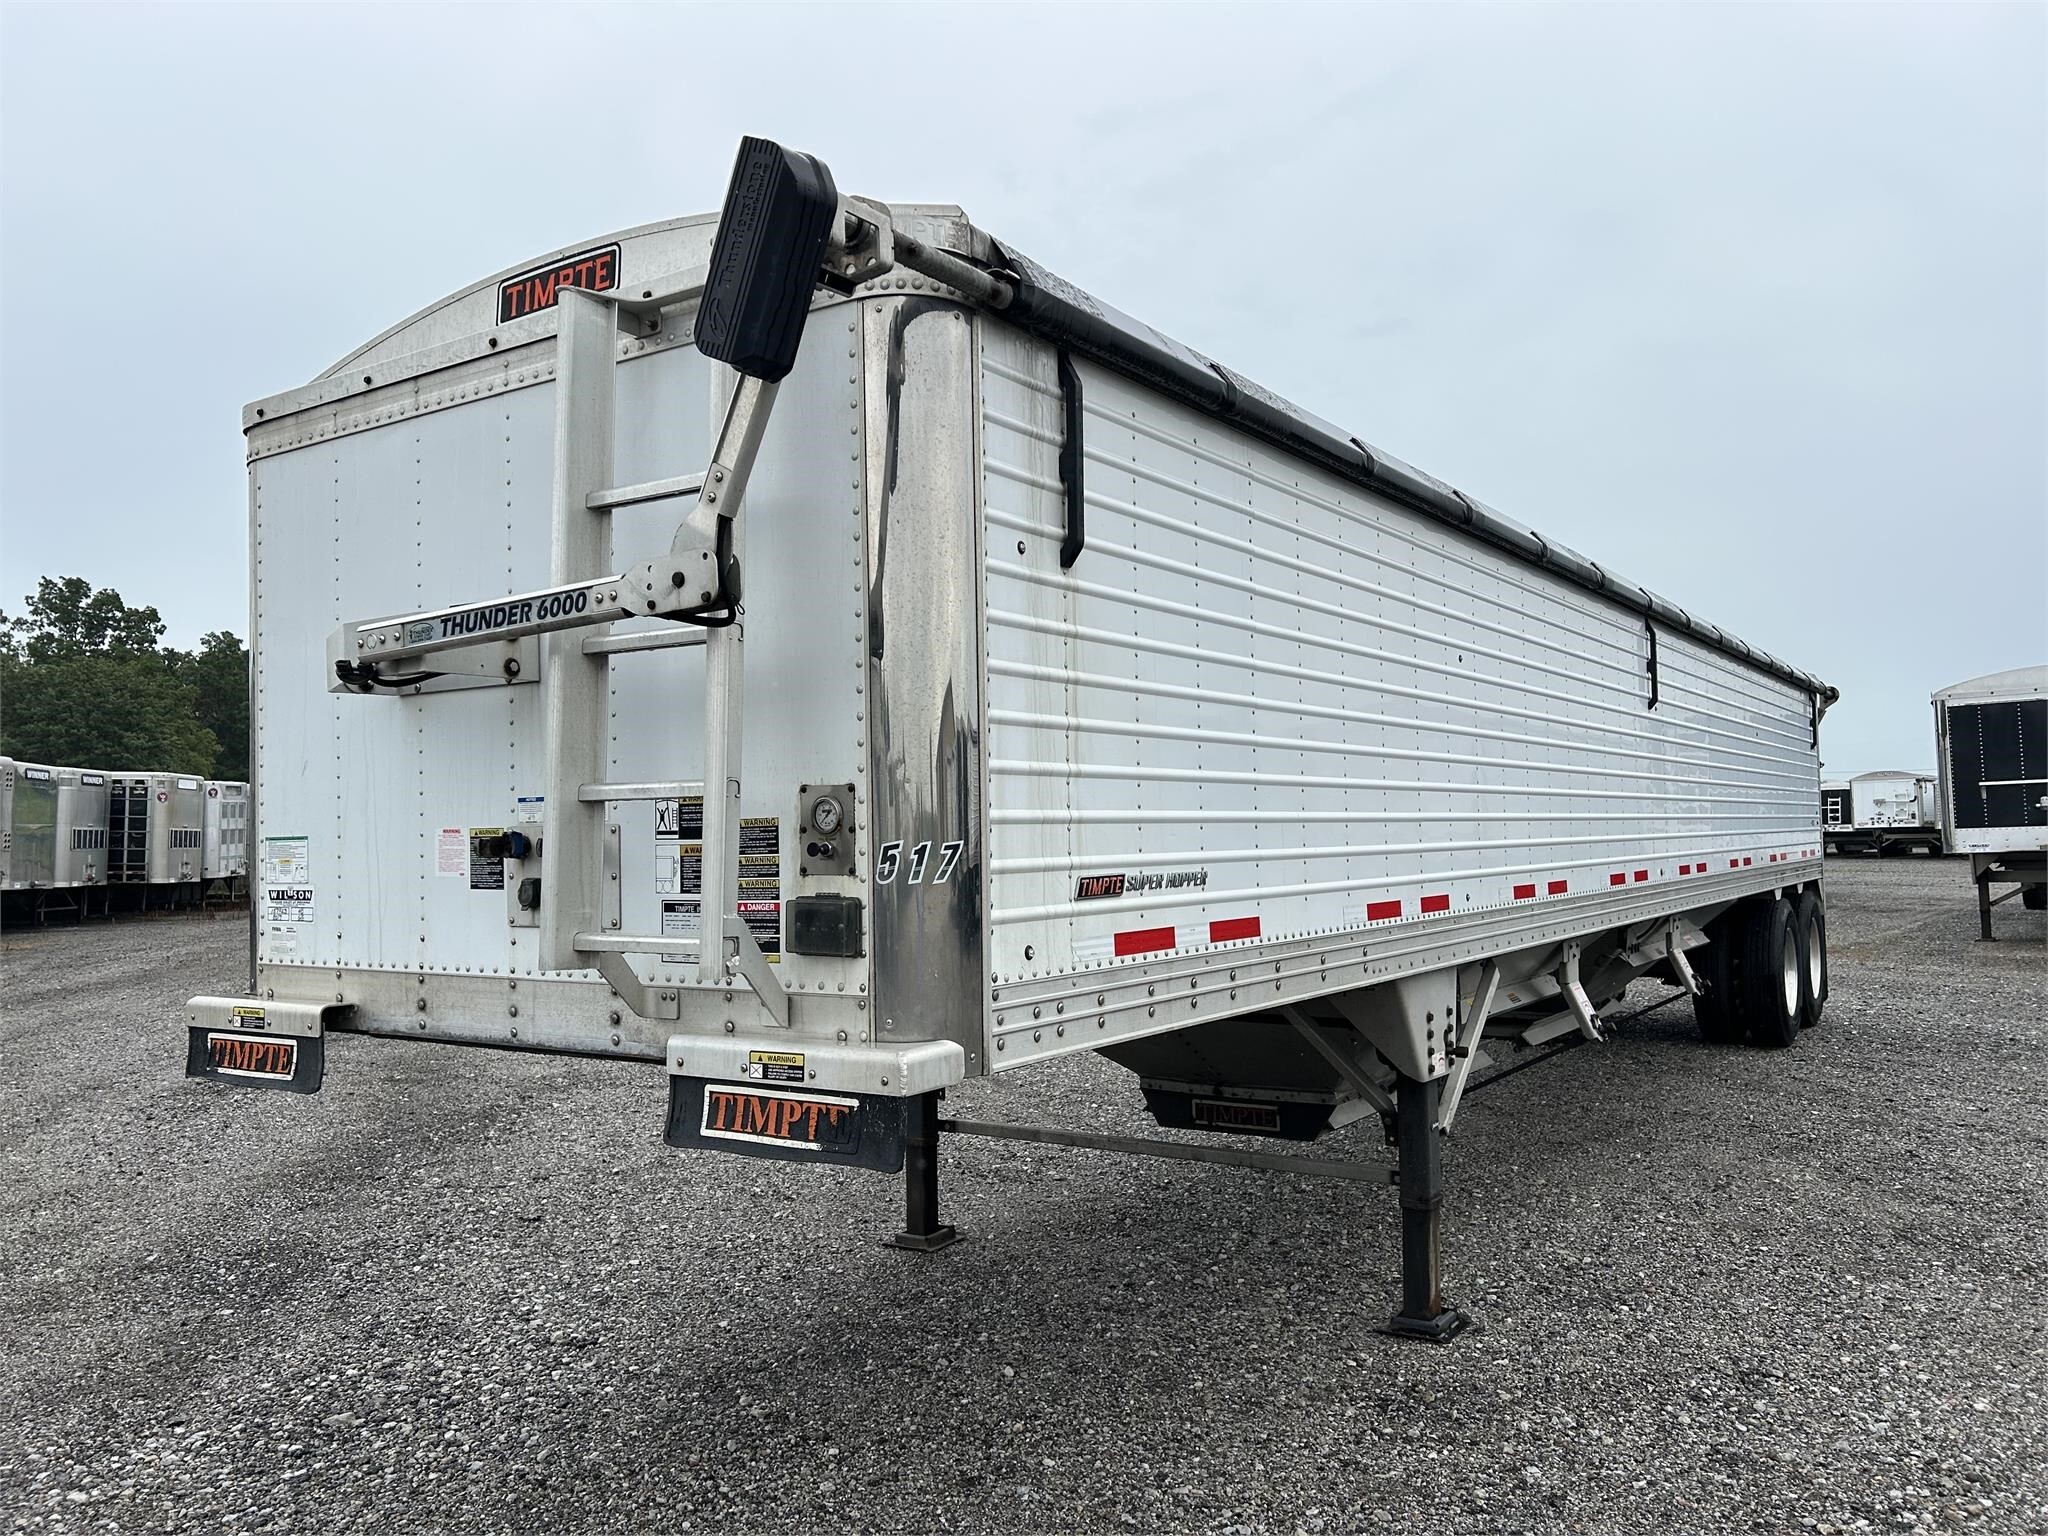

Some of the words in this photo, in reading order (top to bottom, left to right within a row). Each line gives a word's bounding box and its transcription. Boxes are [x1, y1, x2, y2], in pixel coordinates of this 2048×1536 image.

[506, 254, 611, 317] TIMPTE
[440, 602, 532, 637] THUNDER
[536, 591, 588, 621] 6000
[26, 769, 49, 780] WINNER
[82, 775, 104, 785] WINNER
[743, 818, 776, 826] WARNING
[744, 856, 777, 864] WARNING
[875, 840, 965, 885] 517
[1081, 876, 1124, 897] TIMPTE
[1125, 874, 1164, 892] SUPER
[1165, 870, 1208, 889] HOPPER
[270, 890, 311, 900] WILSON
[674, 905, 695, 913] TIMPTE
[747, 903, 775, 911] DANGER
[211, 1039, 292, 1074] TIMPTE
[767, 1055, 797, 1064] WARNING
[1198, 1103, 1274, 1127] TIMPTE
